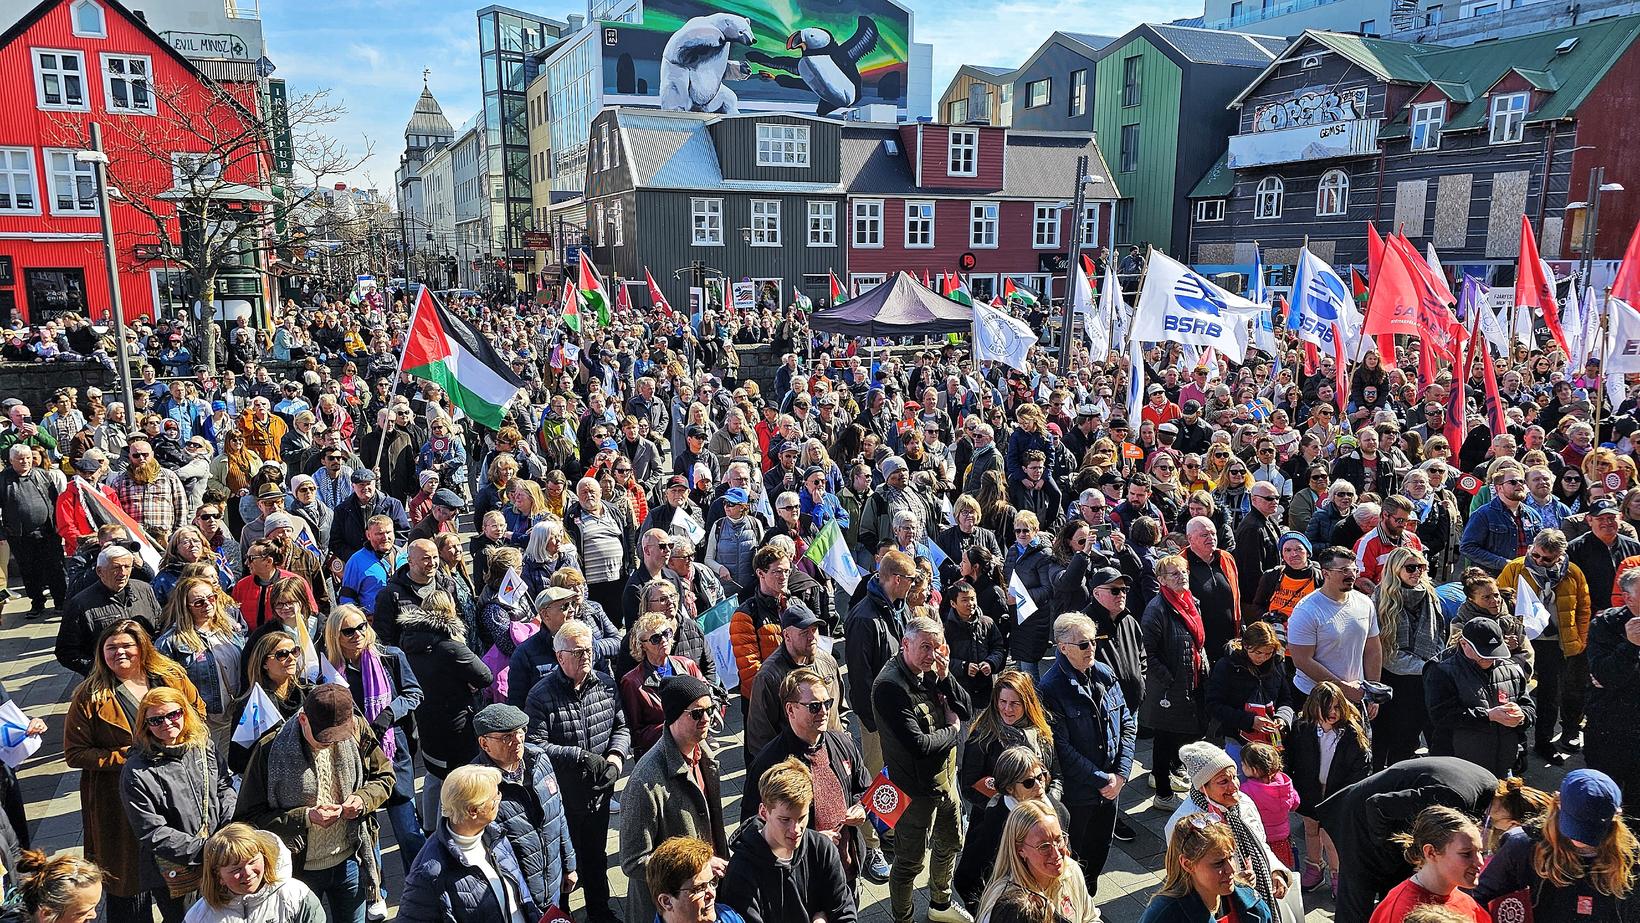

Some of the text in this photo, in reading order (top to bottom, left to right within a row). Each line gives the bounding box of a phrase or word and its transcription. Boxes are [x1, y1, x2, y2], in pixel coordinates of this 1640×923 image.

[175, 38, 199, 51] EVIL
[280, 140, 288, 169] PUB
[1164, 314, 1223, 338] BSRB
